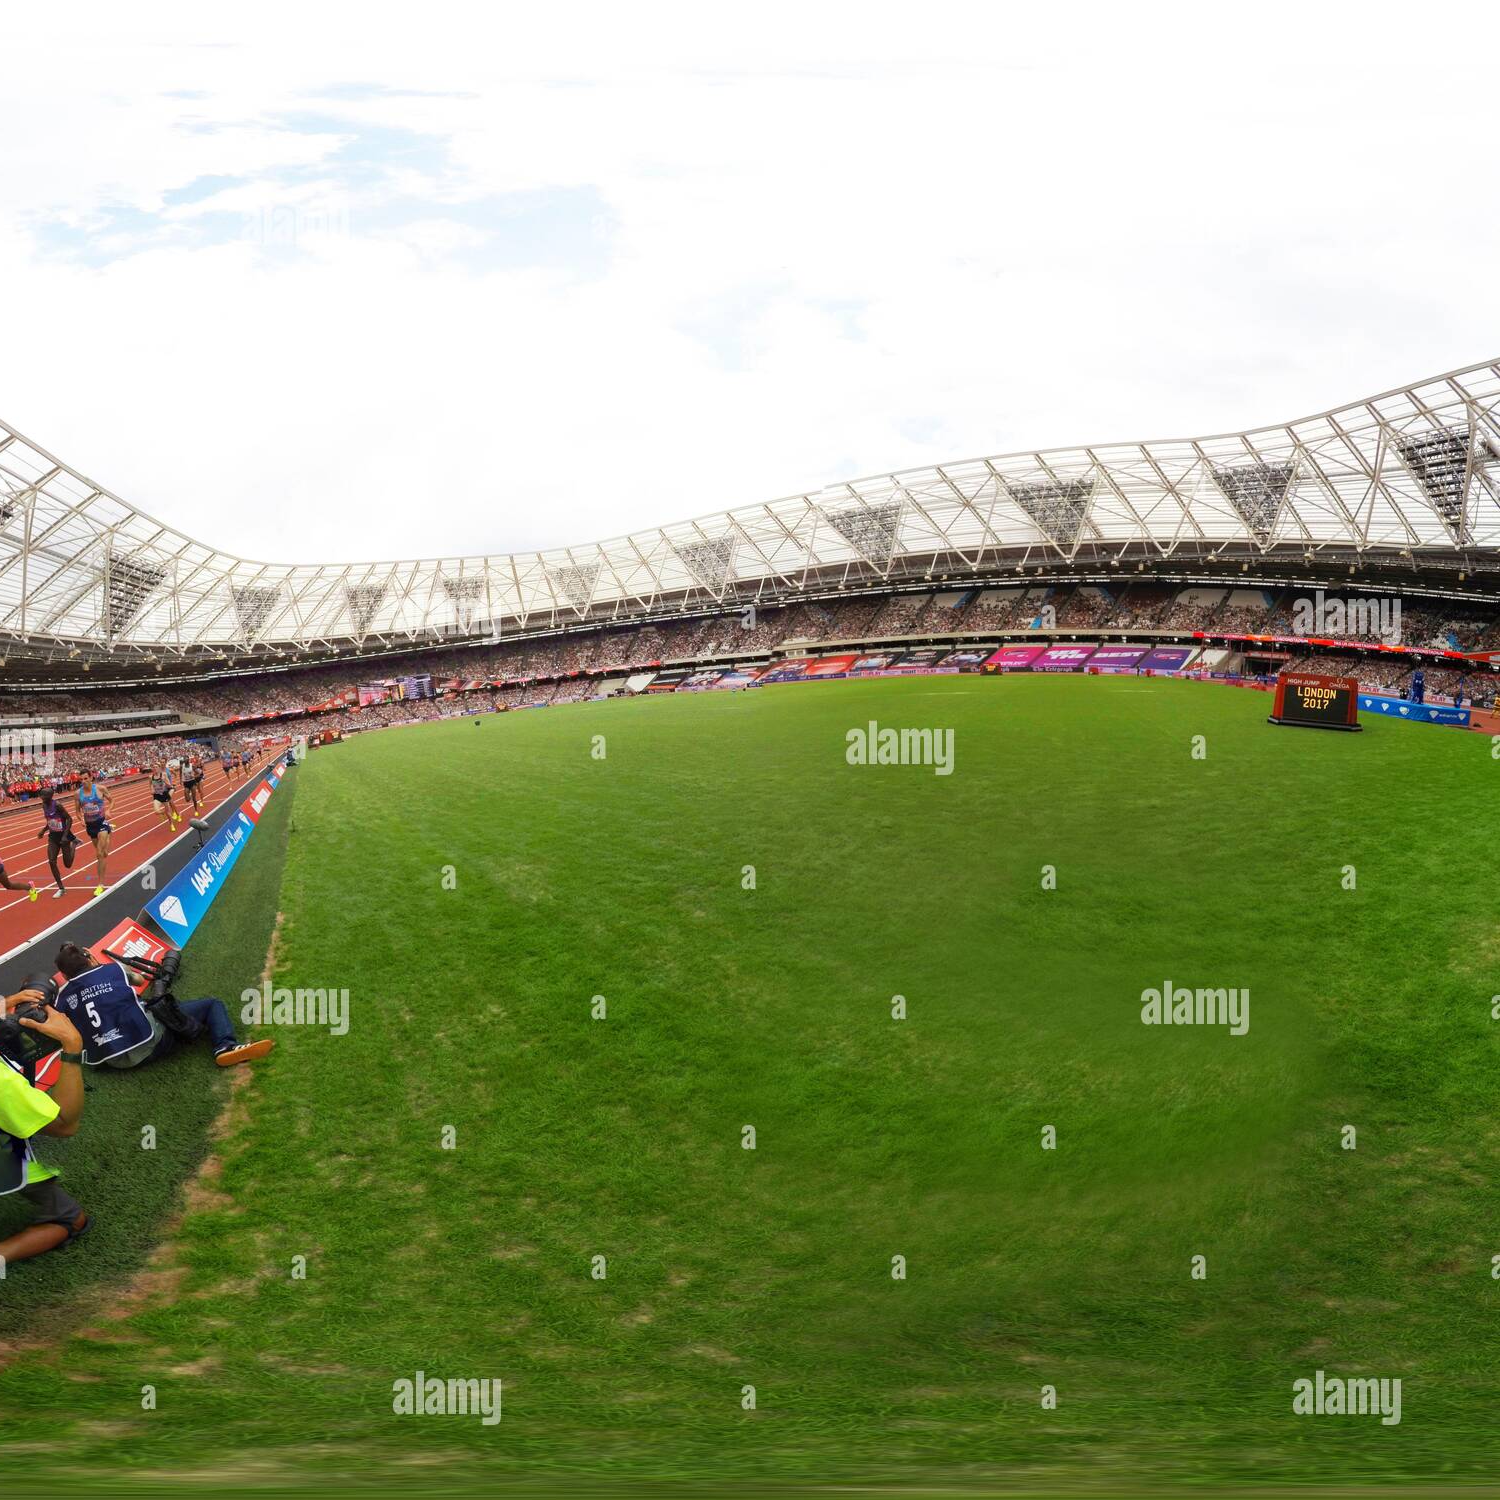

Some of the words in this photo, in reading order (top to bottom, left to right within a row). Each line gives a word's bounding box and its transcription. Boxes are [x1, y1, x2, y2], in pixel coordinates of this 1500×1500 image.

[1298, 687, 1336, 699] LONDON
[1303, 698, 1329, 709] 2017
[190, 861, 214, 896] IAAF
[80, 982, 111, 996] BRITISH
[82, 987, 113, 1002] ATHLETICS
[85, 1001, 101, 1027] 5
